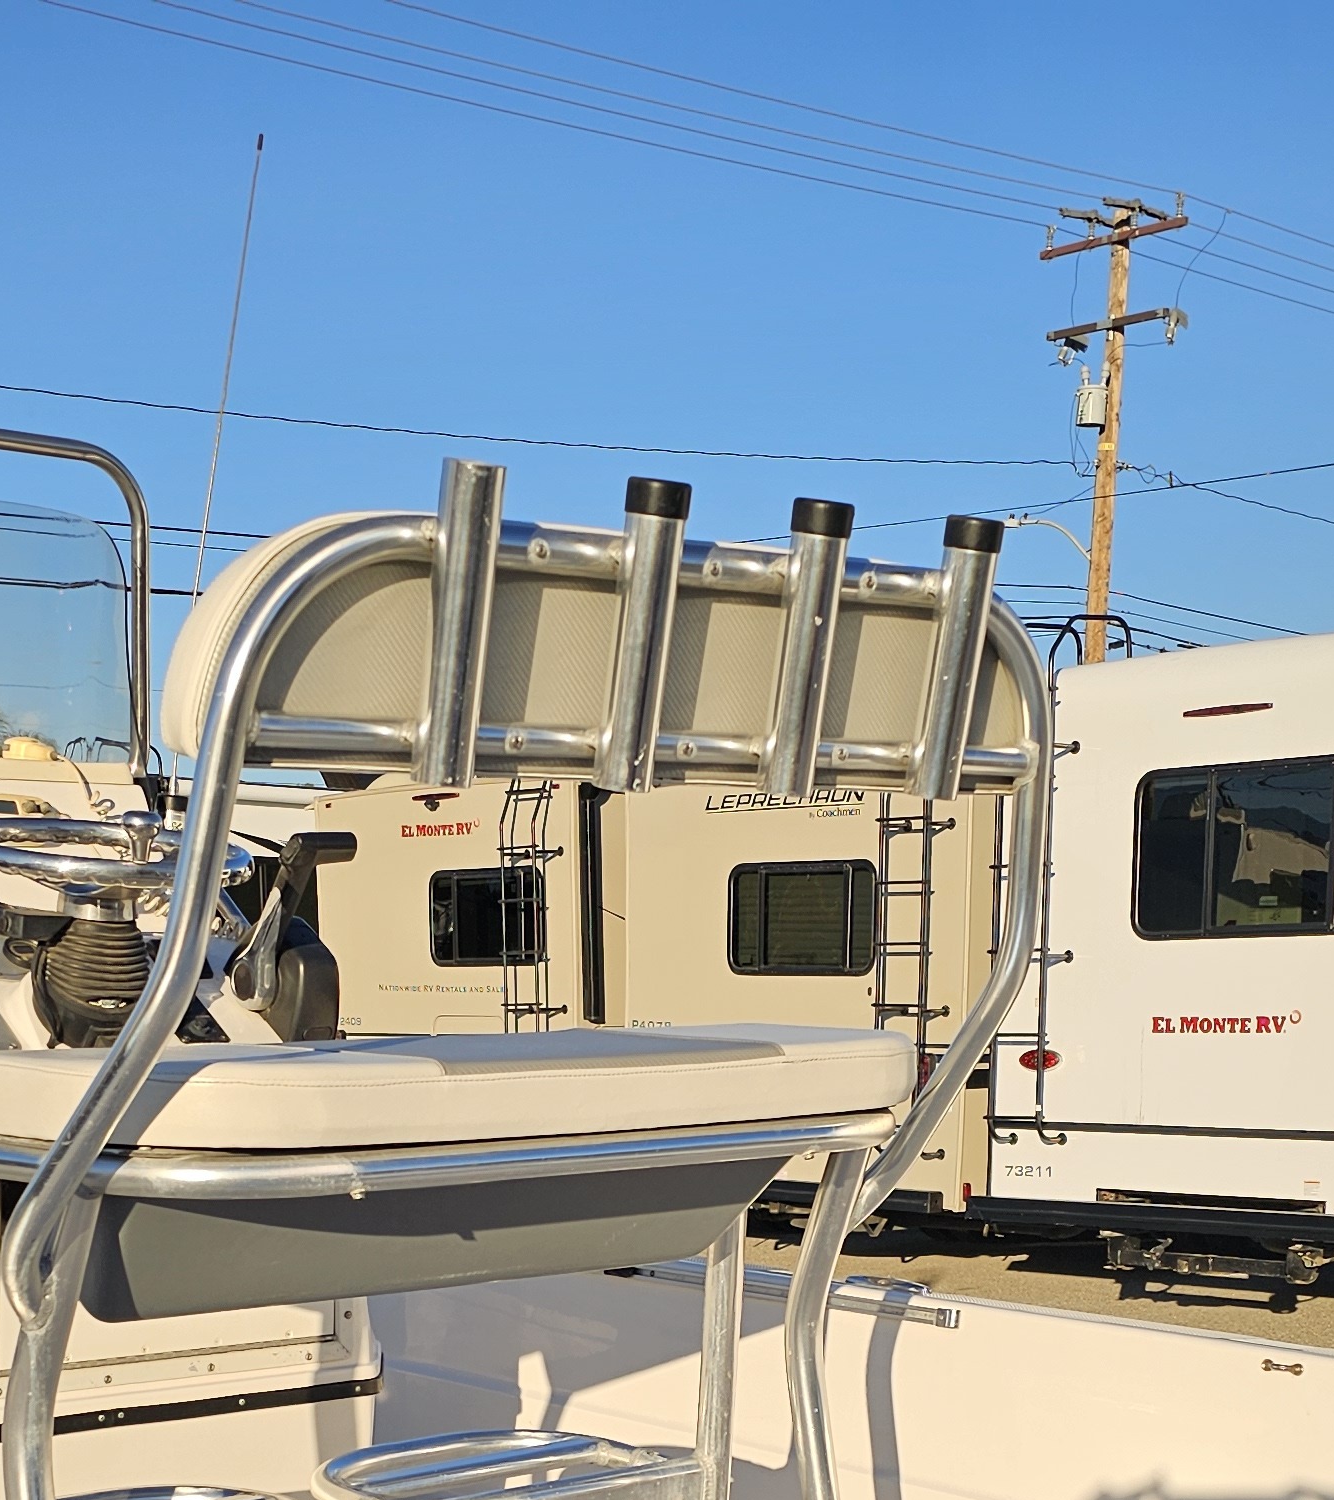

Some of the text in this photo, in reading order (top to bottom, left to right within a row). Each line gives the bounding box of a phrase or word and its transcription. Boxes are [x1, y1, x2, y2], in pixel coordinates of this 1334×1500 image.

[816, 807, 861, 818] Coachmen
[401, 822, 473, 837] EL MONTE RV
[378, 983, 422, 993] NATIONWIDE
[423, 984, 434, 992] RV
[435, 984, 468, 993] RENTALS
[1152, 1016, 1286, 1034] EL MONTE RV
[1005, 1165, 1052, 1178] 73211
